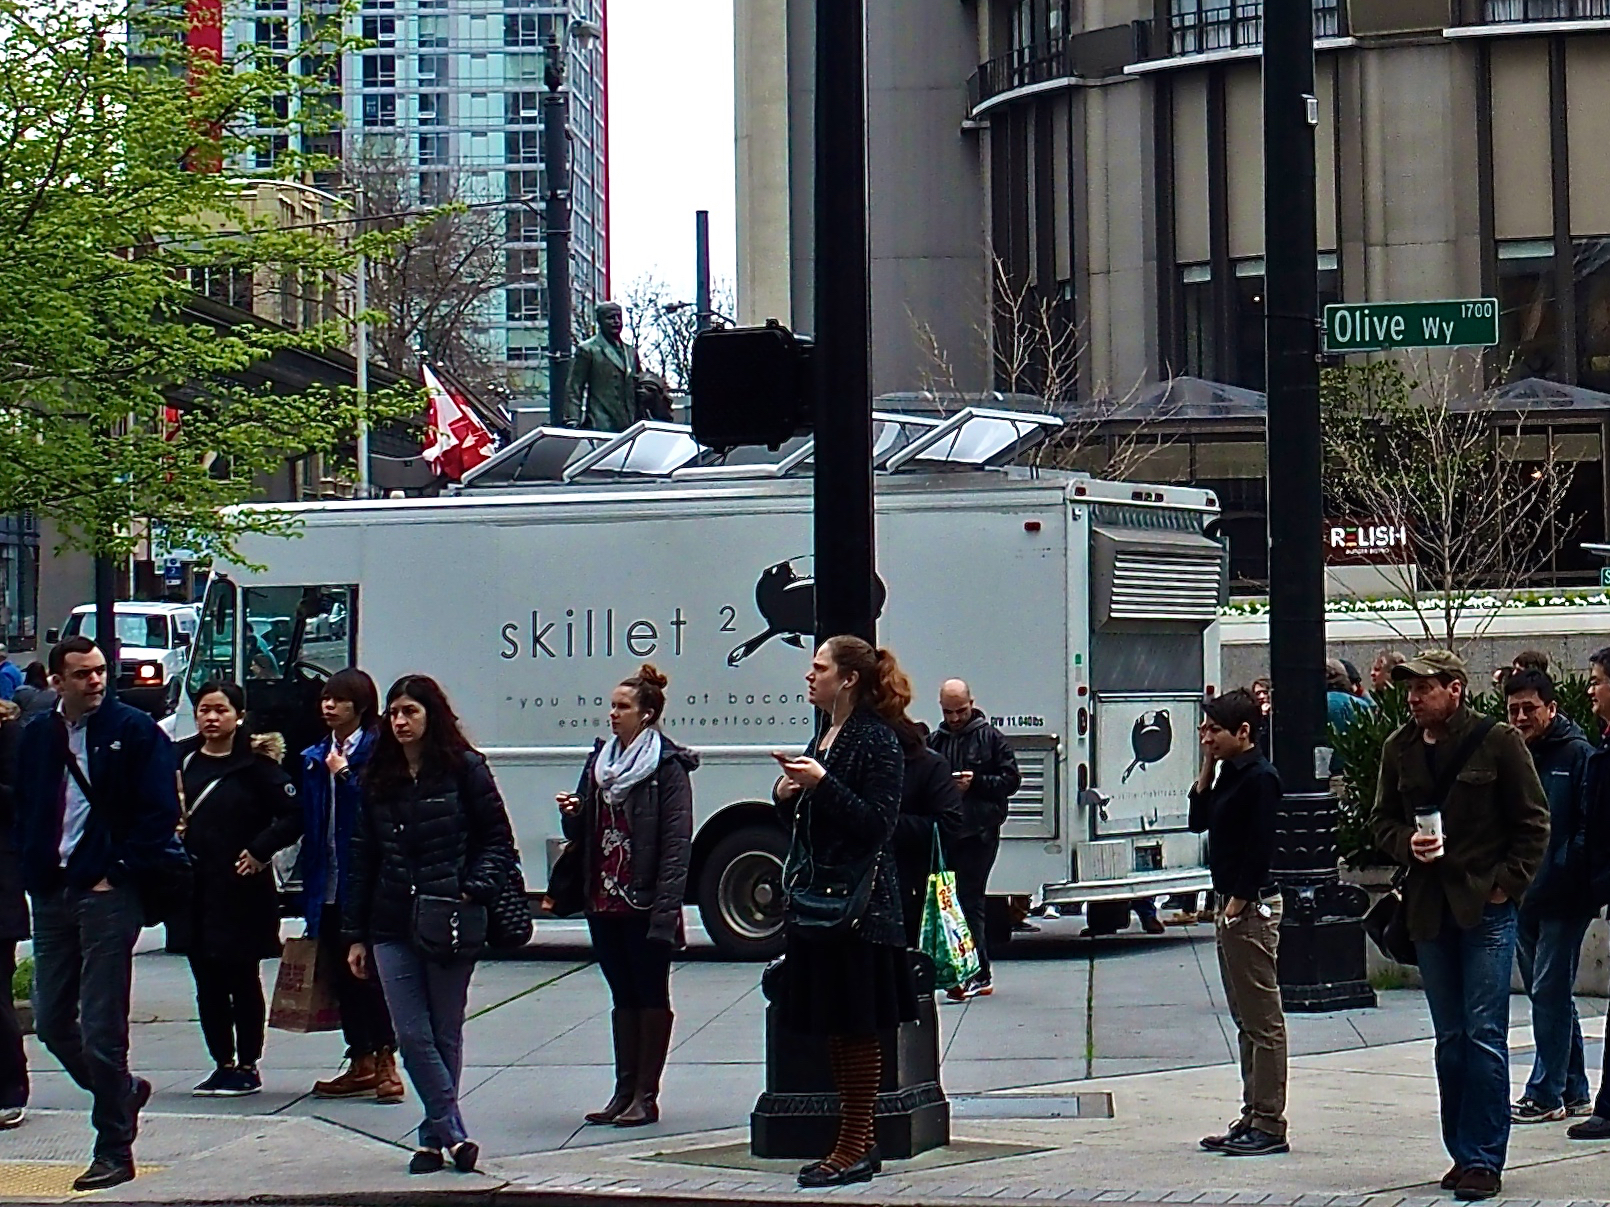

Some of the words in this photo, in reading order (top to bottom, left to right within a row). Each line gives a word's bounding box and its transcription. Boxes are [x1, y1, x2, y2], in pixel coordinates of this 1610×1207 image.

[1461, 304, 1492, 318] 1700
[1334, 309, 1405, 343] Olive
[1422, 316, 1455, 344] Wy
[1330, 525, 1407, 548] RELISH
[500, 607, 688, 659] skillet
[719, 605, 737, 632] 2
[577, 695, 603, 707] ha
[686, 693, 709, 705] at
